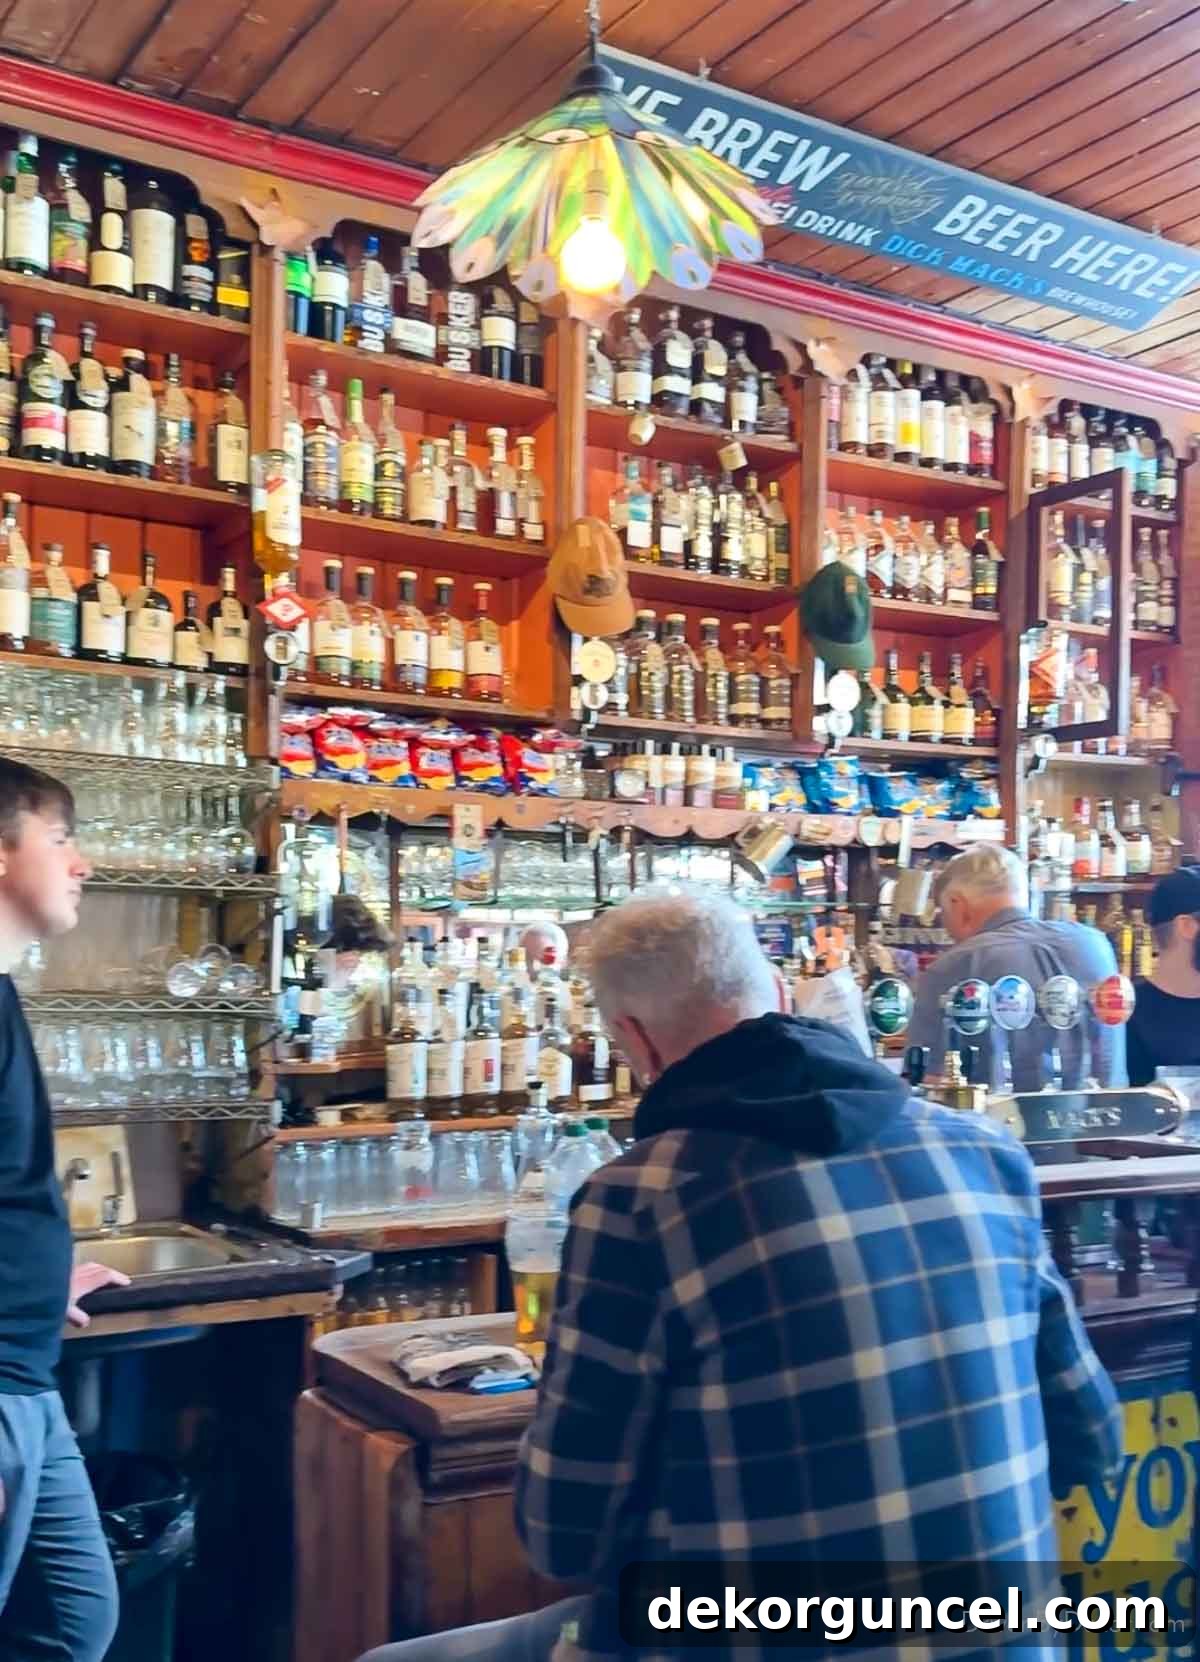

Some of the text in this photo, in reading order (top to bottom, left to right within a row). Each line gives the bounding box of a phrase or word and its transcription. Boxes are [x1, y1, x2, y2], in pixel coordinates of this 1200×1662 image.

[684, 107, 851, 192] BREW
[933, 194, 1064, 263] BEER
[1050, 234, 1200, 303] HERE!
[794, 209, 881, 247] DRINK
[880, 234, 945, 266] DICK
[948, 255, 1049, 296] MACK'S
